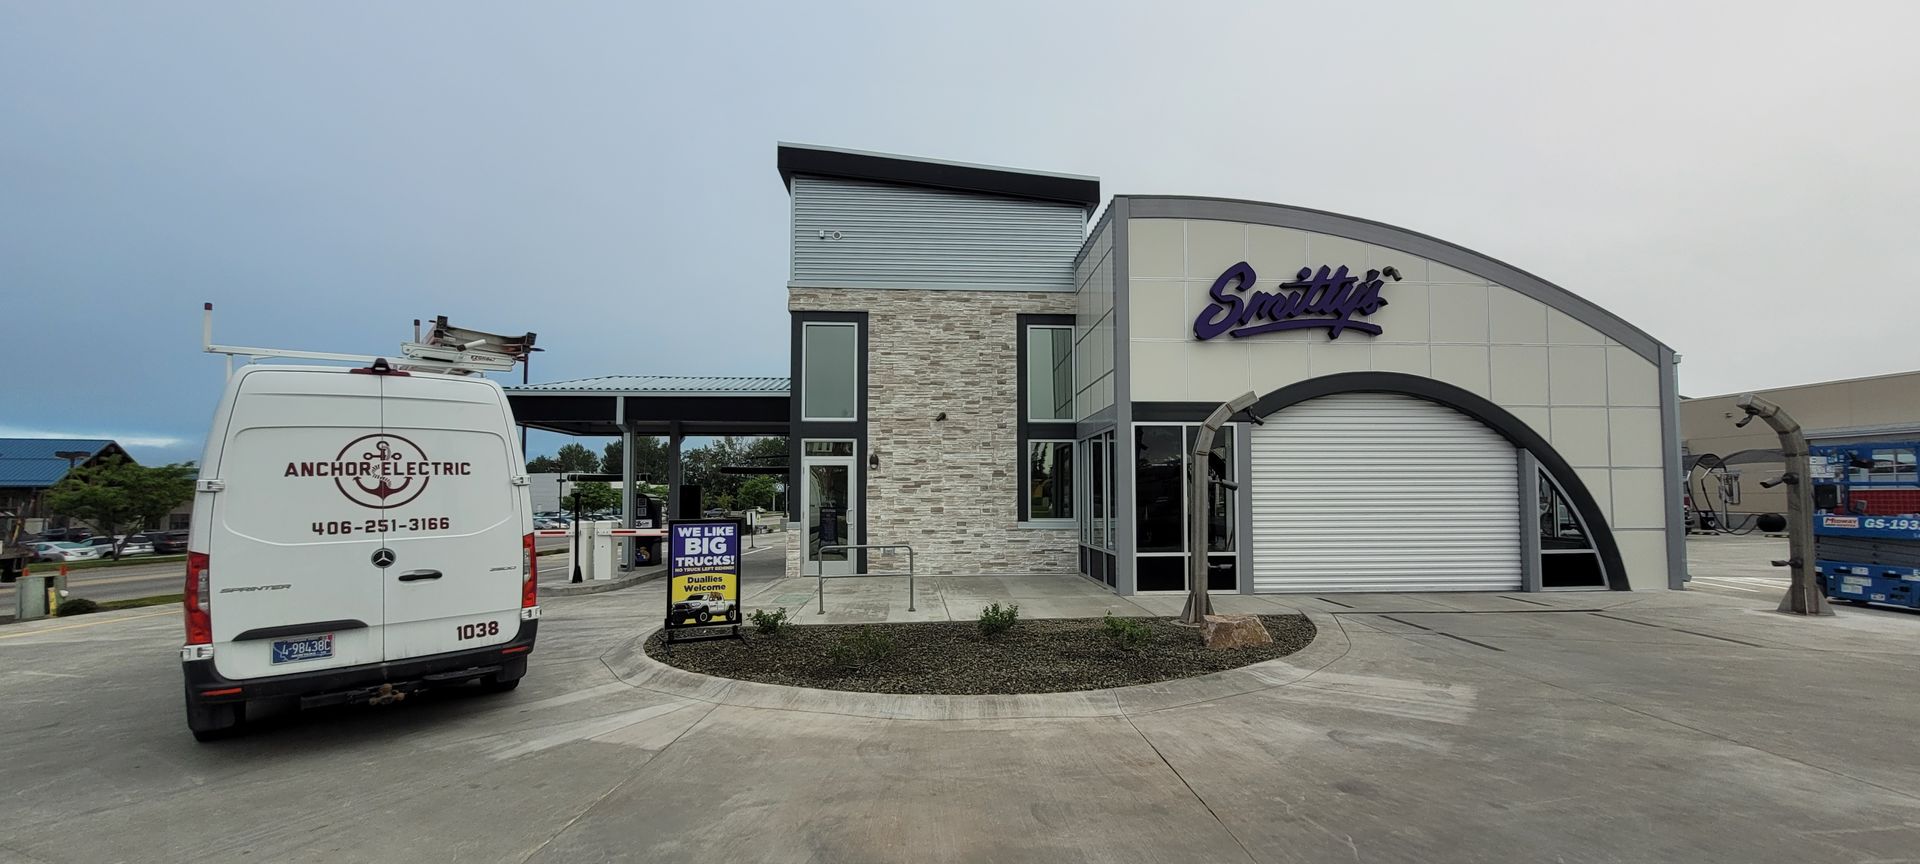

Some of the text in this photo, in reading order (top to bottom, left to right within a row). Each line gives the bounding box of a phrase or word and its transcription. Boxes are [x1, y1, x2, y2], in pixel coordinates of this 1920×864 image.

[1193, 261, 1388, 340] Smitty's
[284, 461, 471, 477] ANCHOR ELECTRIC
[312, 517, 450, 535] 406-251-3166
[1864, 518, 1920, 530] GS-193
[678, 526, 734, 537] WE LIKE
[684, 536, 727, 555] BIG
[675, 555, 735, 567] TRUCKS!
[687, 575, 723, 584] Duallies
[219, 584, 292, 593] SPRINTER
[683, 584, 726, 592] Welcome
[457, 620, 499, 641] 1038
[282, 639, 331, 656] 4-98438C
